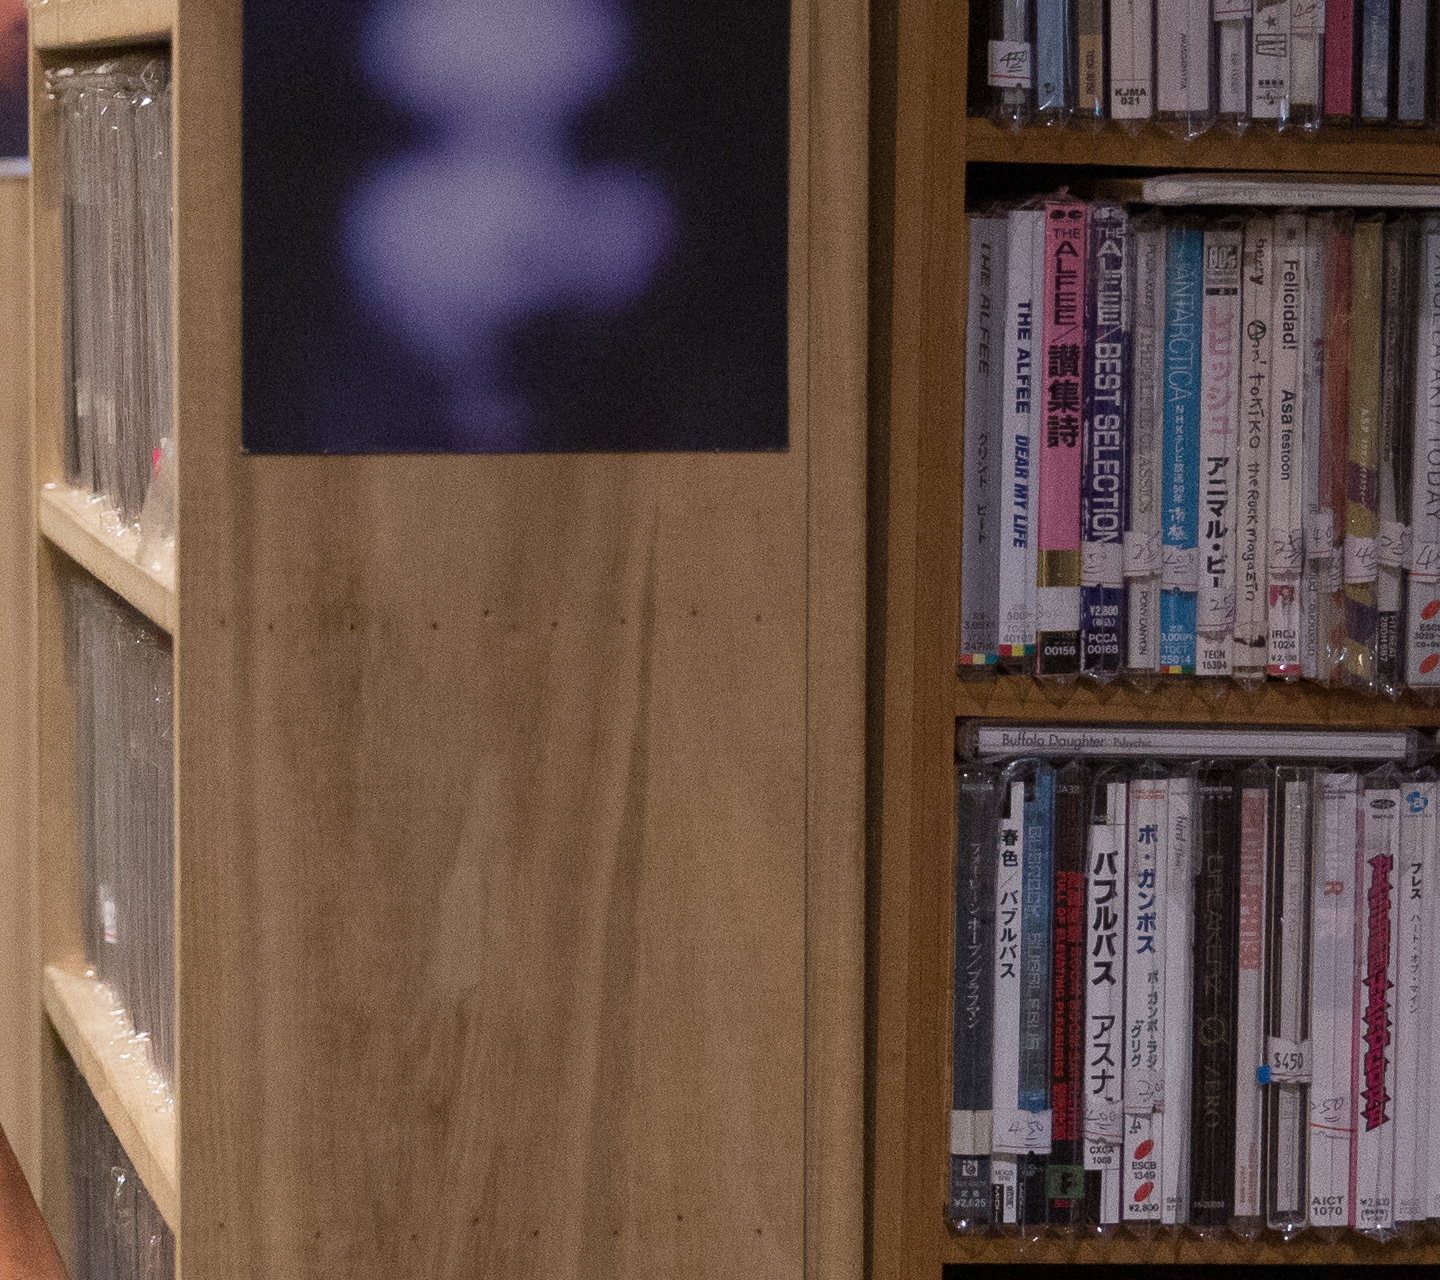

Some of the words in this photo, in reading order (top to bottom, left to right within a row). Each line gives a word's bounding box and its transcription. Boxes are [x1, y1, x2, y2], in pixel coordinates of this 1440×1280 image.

[1115, 88, 1147, 96] KJMA
[1052, 228, 1081, 239] THE
[979, 242, 992, 286] THE
[1017, 300, 1032, 340] THE
[1281, 259, 1300, 351] Felicidad!
[976, 295, 991, 376] ALFEE
[1016, 347, 1031, 414] ALFEE
[1280, 388, 1297, 425] Asa
[1013, 434, 1030, 480] DEAR
[1280, 428, 1294, 481] festoon
[1092, 412, 1121, 544] SELECTION
[1013, 483, 1029, 511] MY
[1012, 514, 1028, 549] LIFE
[1088, 633, 1118, 644] PCCA
[1138, 621, 1148, 656] CANYON
[1272, 640, 1296, 650] 1024
[1001, 735, 1045, 748] Buffalo
[1049, 735, 1105, 750] Daughter
[1136, 824, 1158, 955] ボ・ガンボス
[1410, 862, 1422, 899] ブレス
[1091, 851, 1119, 986] バブルバス
[1131, 1161, 1157, 1170] ESCB
[1134, 1171, 1156, 1179] 1349
[1312, 1196, 1344, 1206] AICT
[1313, 1207, 1343, 1216] 1070
